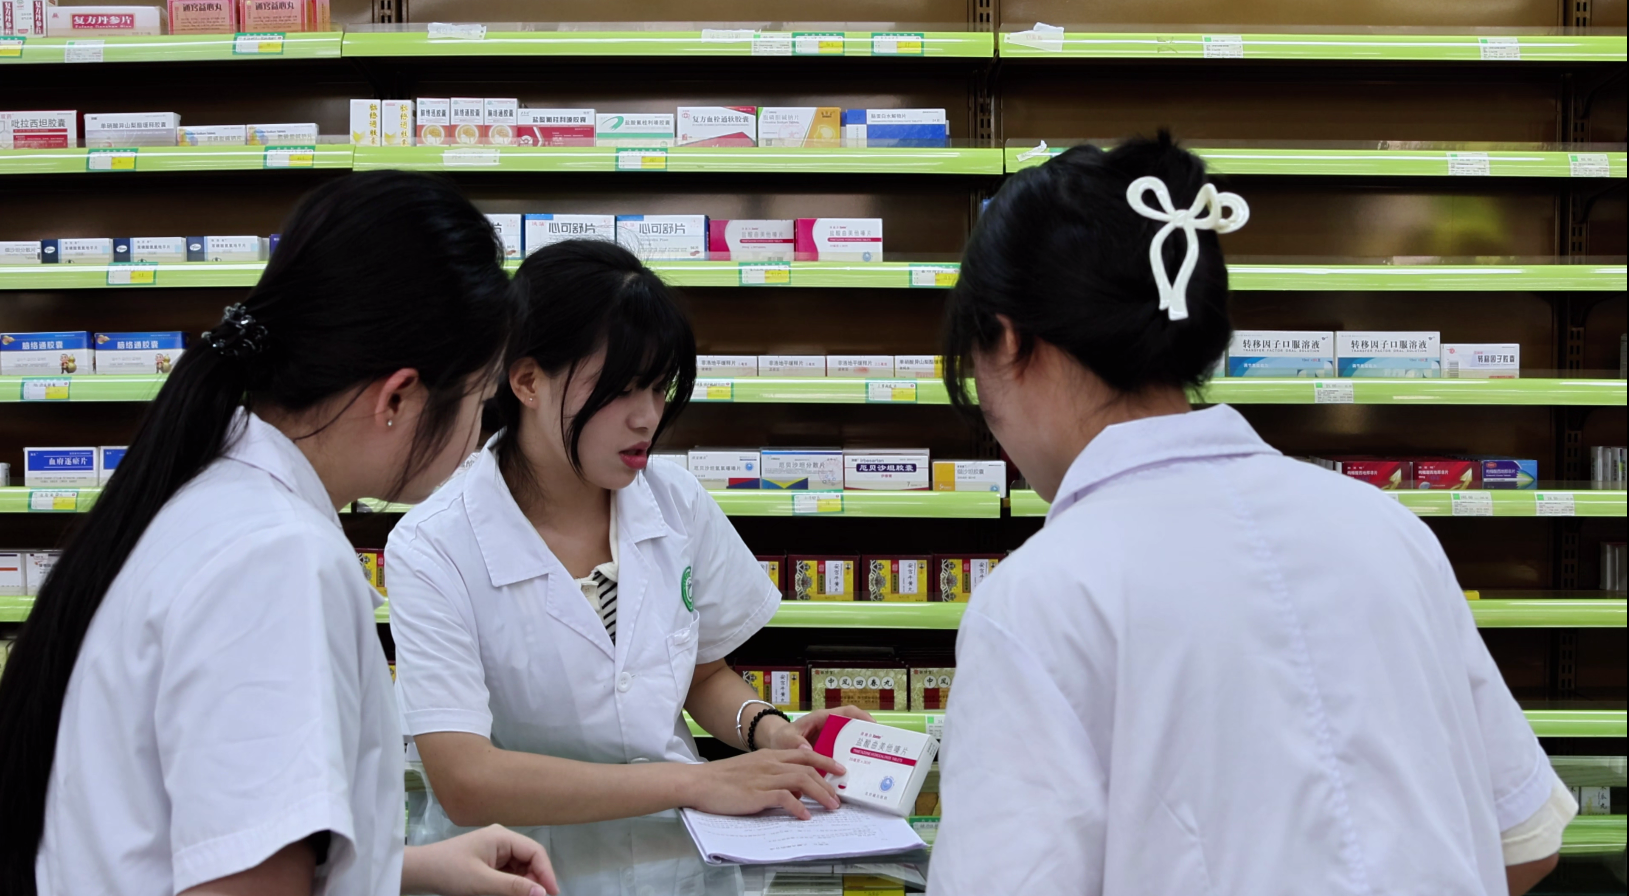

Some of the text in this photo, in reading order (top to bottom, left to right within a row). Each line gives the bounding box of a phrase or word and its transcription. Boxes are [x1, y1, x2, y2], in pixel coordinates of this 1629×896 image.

[74, 16, 132, 24] 复方丹参片
[420, 109, 447, 117] 脑络通胶囊
[454, 108, 480, 116] 脑络通胶囊
[488, 108, 514, 117] 脑络通胶囊
[11, 119, 66, 128] 吡拉西坦胶囊
[692, 115, 750, 123] 复方血栓通软胶囊
[548, 222, 596, 233] 心可舒片
[640, 224, 686, 234] 心可舒片
[22, 342, 64, 350] 脑络通胶囊
[116, 340, 158, 349] 脑络通胶囊
[1243, 340, 1320, 349] 转移因子口服溶液
[1351, 340, 1427, 349] 转移因子口服溶液
[1478, 354, 1515, 362] 转移因子胶囊
[49, 458, 88, 466] 血府逐瘀片
[828, 678, 892, 687] 中风回春丸
[855, 738, 909, 756] 盐酸曲美他嗪片
